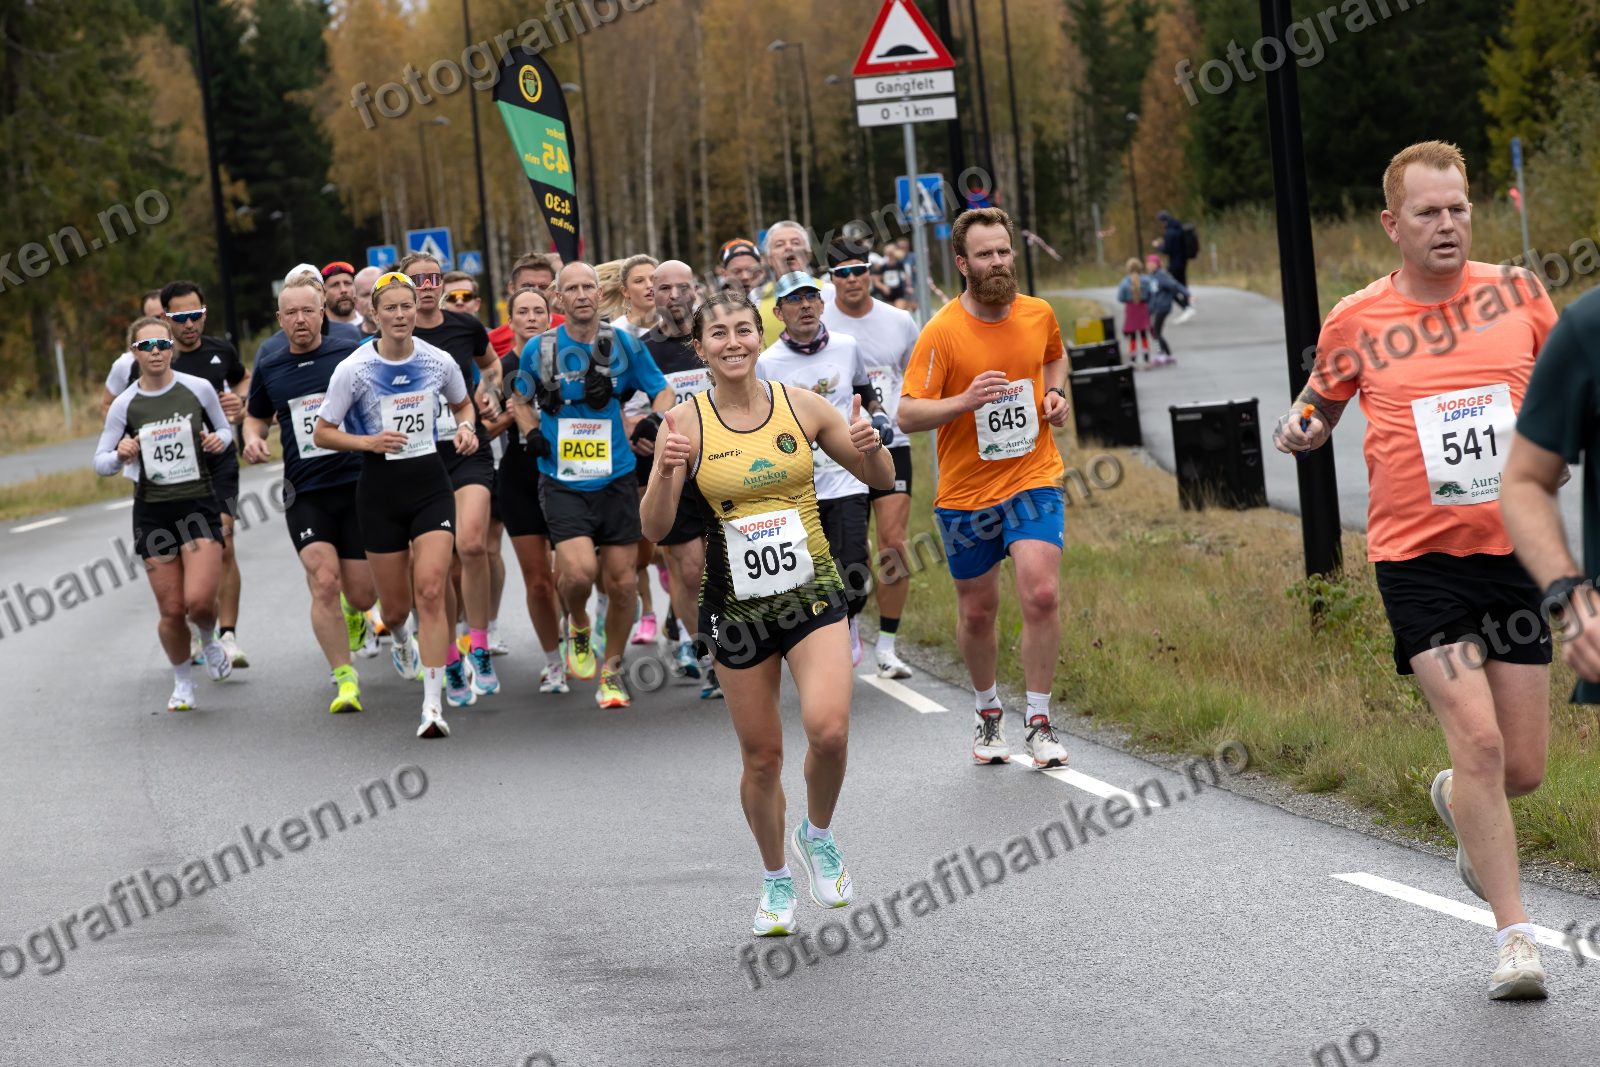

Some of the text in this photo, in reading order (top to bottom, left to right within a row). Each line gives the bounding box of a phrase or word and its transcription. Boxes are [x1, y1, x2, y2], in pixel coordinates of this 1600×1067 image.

[875, 78, 935, 95] Gangfelt
[881, 108, 890, 120] 0
[673, 374, 704, 383] NORGES
[393, 394, 425, 405] NORGES
[396, 402, 420, 411] LØPET
[1435, 394, 1493, 412] NORGES
[988, 406, 1027, 433] 645
[1444, 406, 1486, 422] LØPET
[151, 426, 182, 437] NORGES
[393, 413, 425, 434] 725
[154, 432, 177, 442] LØPET
[1005, 437, 1034, 449] Aursko
[1442, 424, 1497, 466] 541
[153, 442, 185, 463] 452
[563, 441, 606, 458] PACE
[708, 450, 735, 461] CRAFT
[743, 469, 788, 486] Aurskog
[739, 516, 787, 534] NORGES
[747, 527, 782, 542] LØPET
[744, 541, 797, 580] 905
